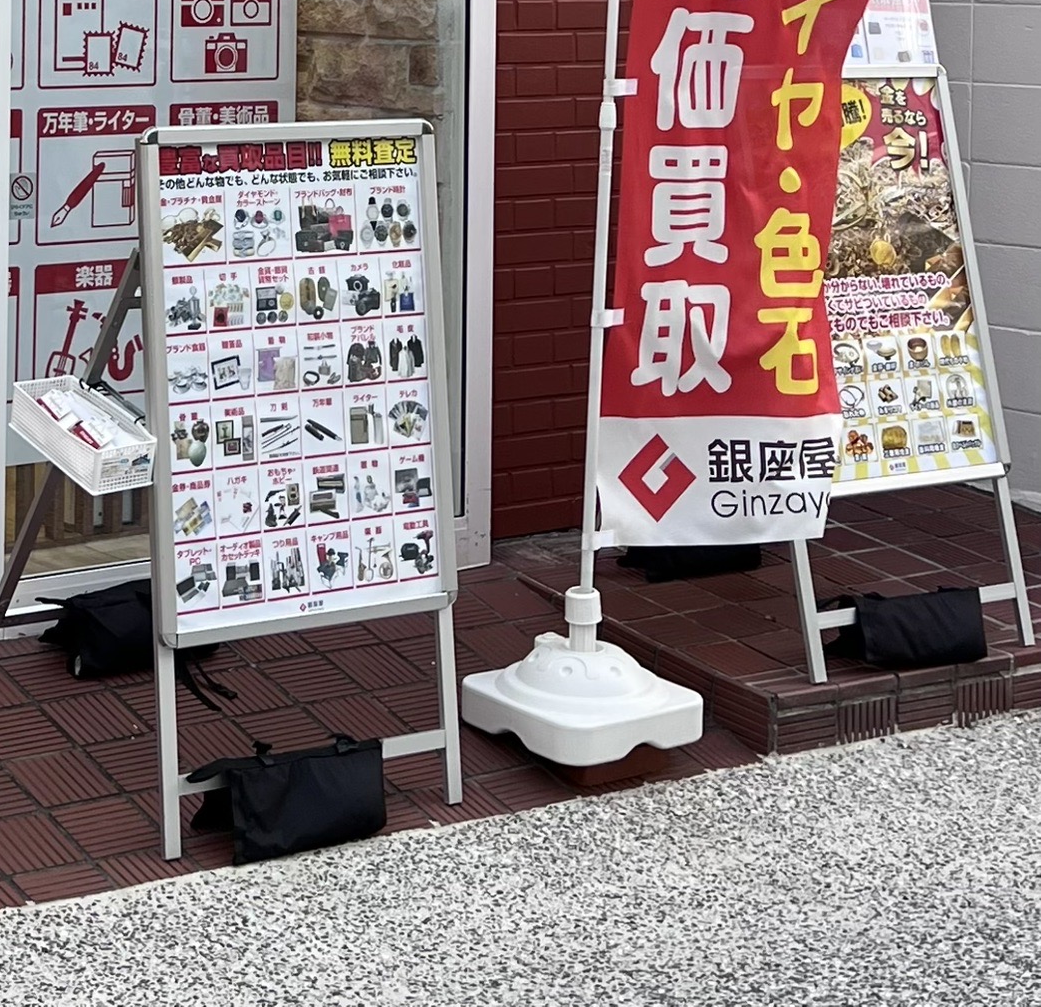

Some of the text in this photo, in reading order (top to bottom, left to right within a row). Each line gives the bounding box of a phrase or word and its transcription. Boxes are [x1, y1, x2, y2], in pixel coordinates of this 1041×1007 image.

[879, 84, 908, 106] 金を
[42, 111, 152, 135] 万年筆・ライター
[841, 99, 866, 127] 騰!
[881, 108, 928, 127] 売るなら
[328, 137, 418, 169] 無料査定
[883, 126, 929, 169] 今!
[237, 198, 281, 208] カラーストーン
[350, 262, 369, 271] カメラ
[75, 265, 114, 289] 楽器
[350, 325, 375, 334] ブランド
[830, 310, 950, 332] ものでもご相談下さい。
[352, 394, 378, 403] ライター
[399, 389, 418, 398] テレカ
[708, 437, 836, 483] 銀座屋
[227, 475, 248, 485] ハガキ
[711, 490, 831, 518] Ginzay
[310, 530, 349, 543] キャンプ用品
[189, 557, 202, 566] PC
